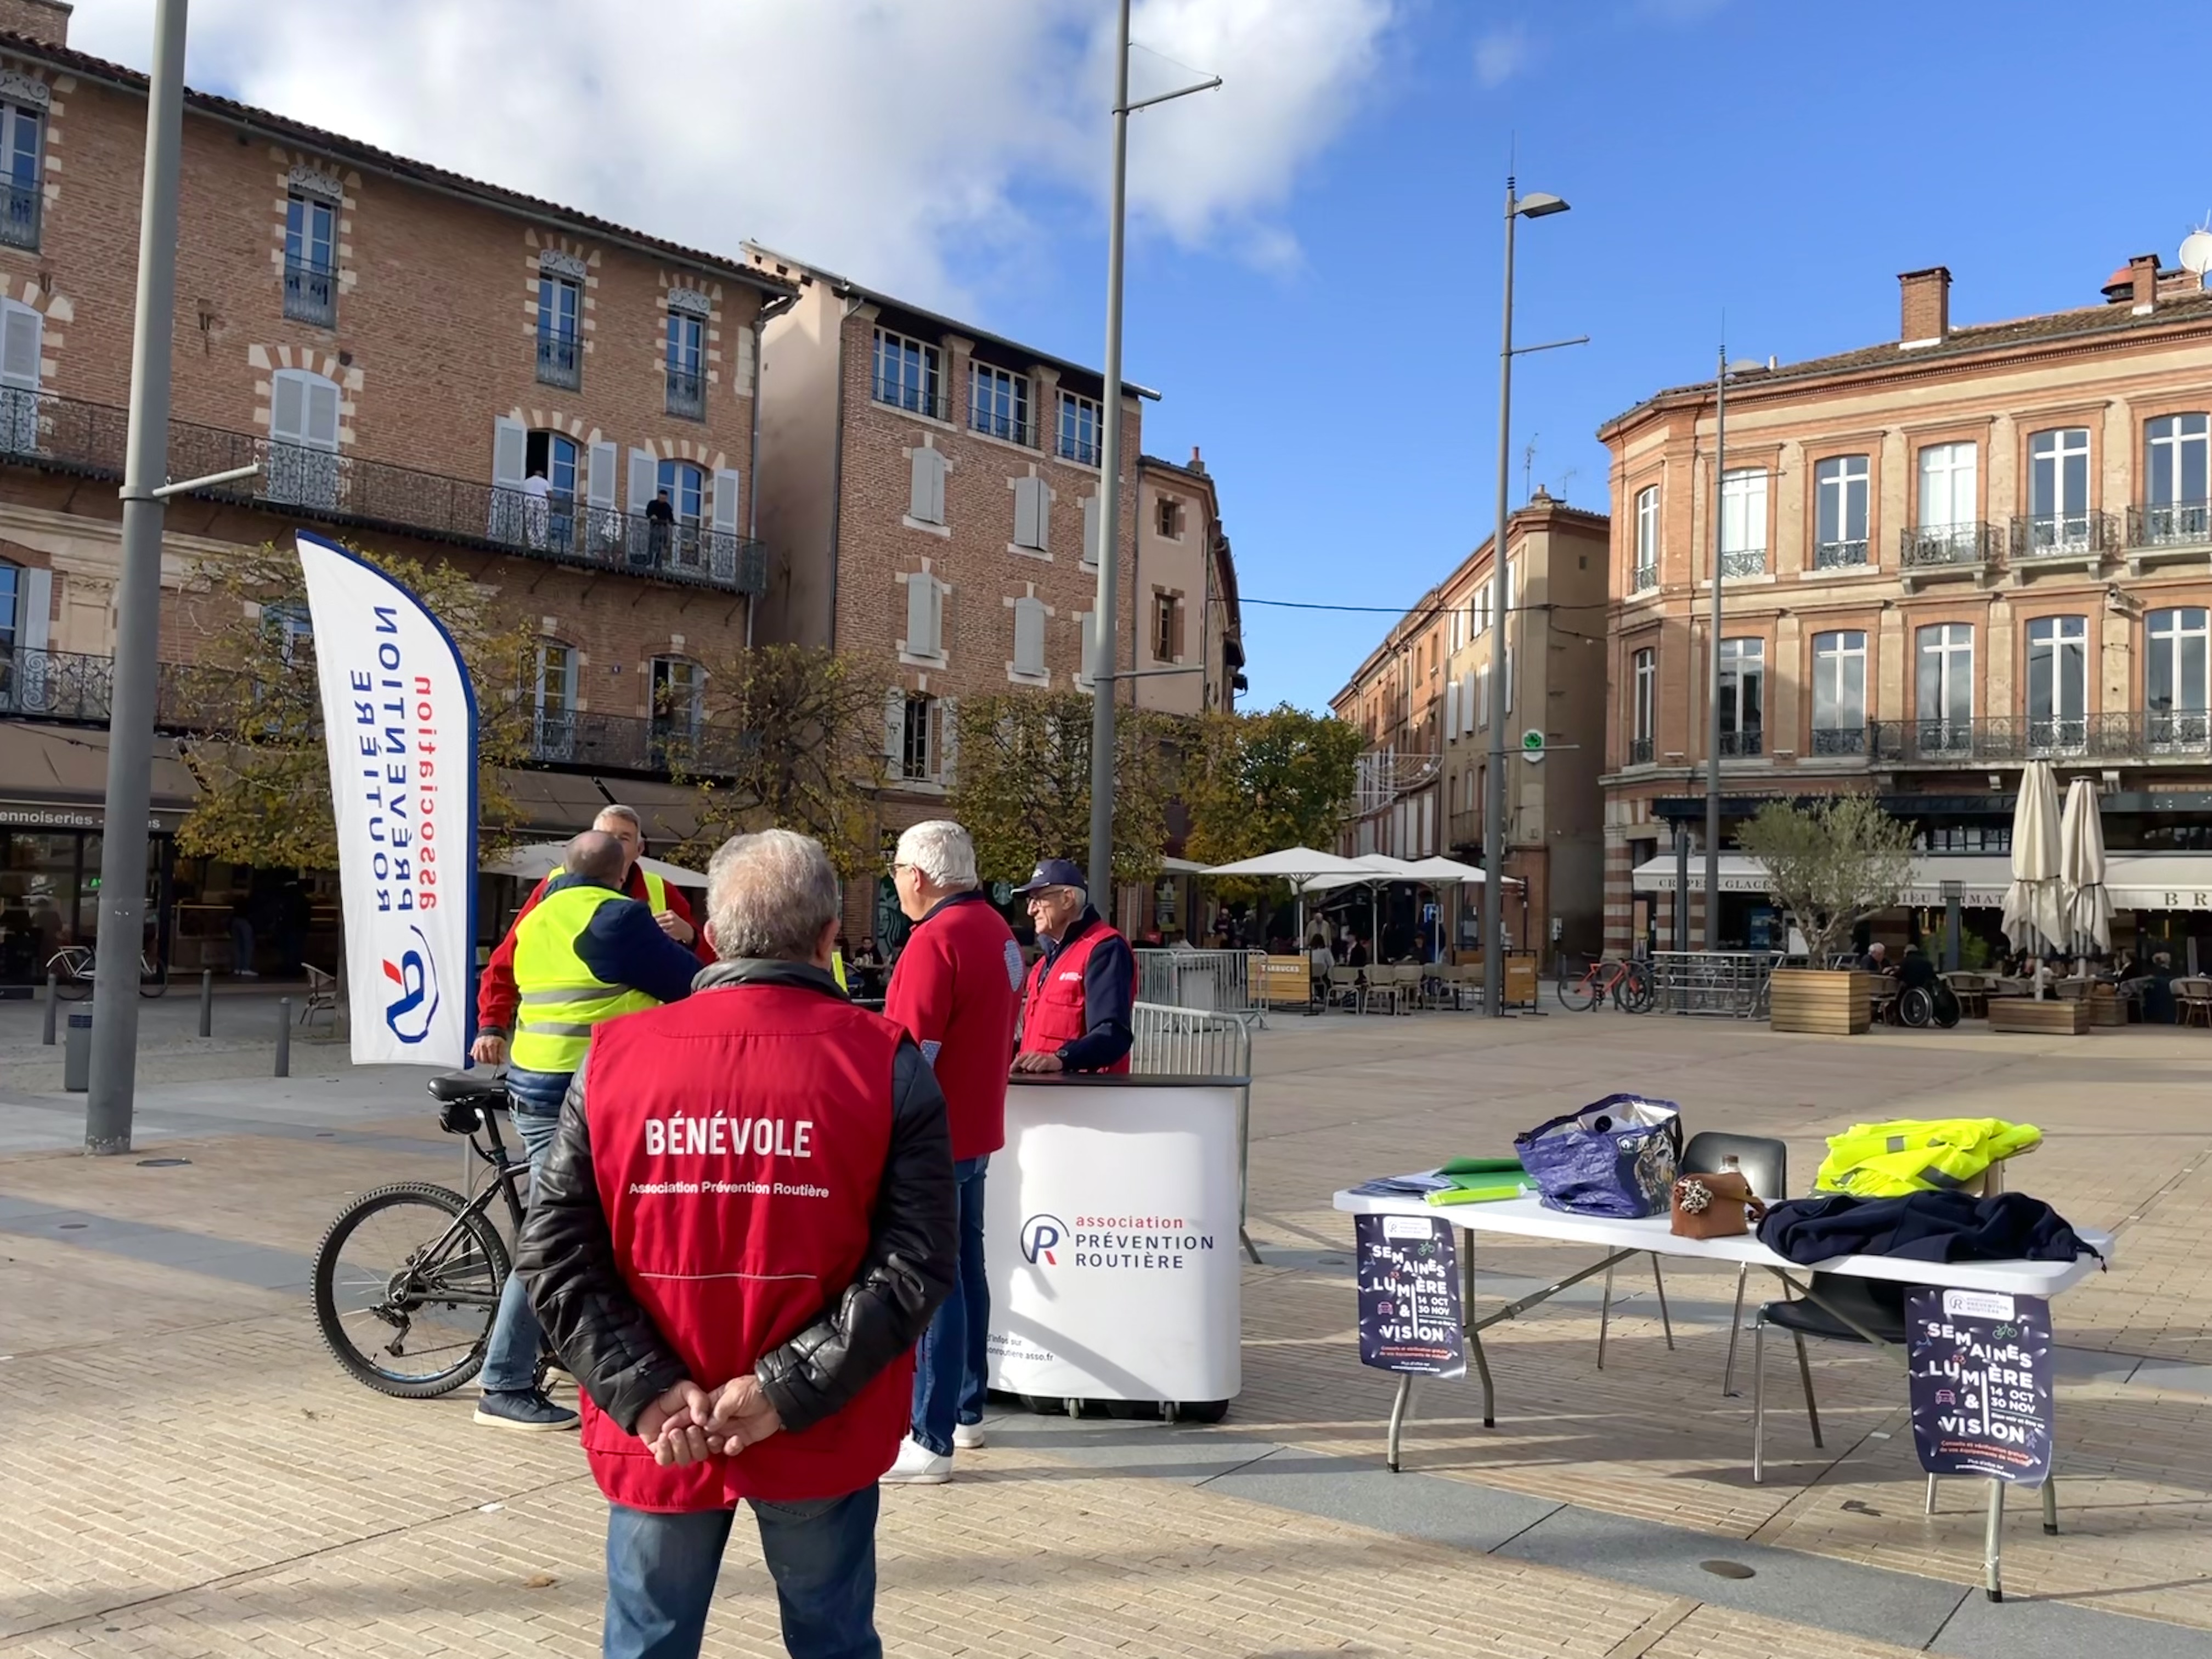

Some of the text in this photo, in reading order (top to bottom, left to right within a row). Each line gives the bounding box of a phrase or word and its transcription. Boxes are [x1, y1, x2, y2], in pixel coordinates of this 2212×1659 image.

[645, 1110, 814, 1158] BÉNÉVOLE
[629, 1181, 830, 1198] Association Prévention Routière
[1076, 1215, 1183, 1229] association
[1076, 1232, 1214, 1250] PRÉVENTION
[1076, 1251, 1183, 1269] ROUTIÈRE
[1372, 1245, 1446, 1278] SEMAINES
[1431, 1297, 1448, 1306] OCT
[1399, 1304, 1410, 1317] &
[1431, 1306, 1450, 1316] NOV
[1380, 1324, 1444, 1342] VISION
[1927, 1322, 2033, 1369] SEMAINES
[1929, 1360, 2034, 1390] LUMIÈRE
[1964, 1393, 1980, 1410] &
[1989, 1386, 2035, 1403] 14 OCT
[1990, 1397, 2036, 1414] 30 NOV
[1940, 1416, 2025, 1444] VISION
